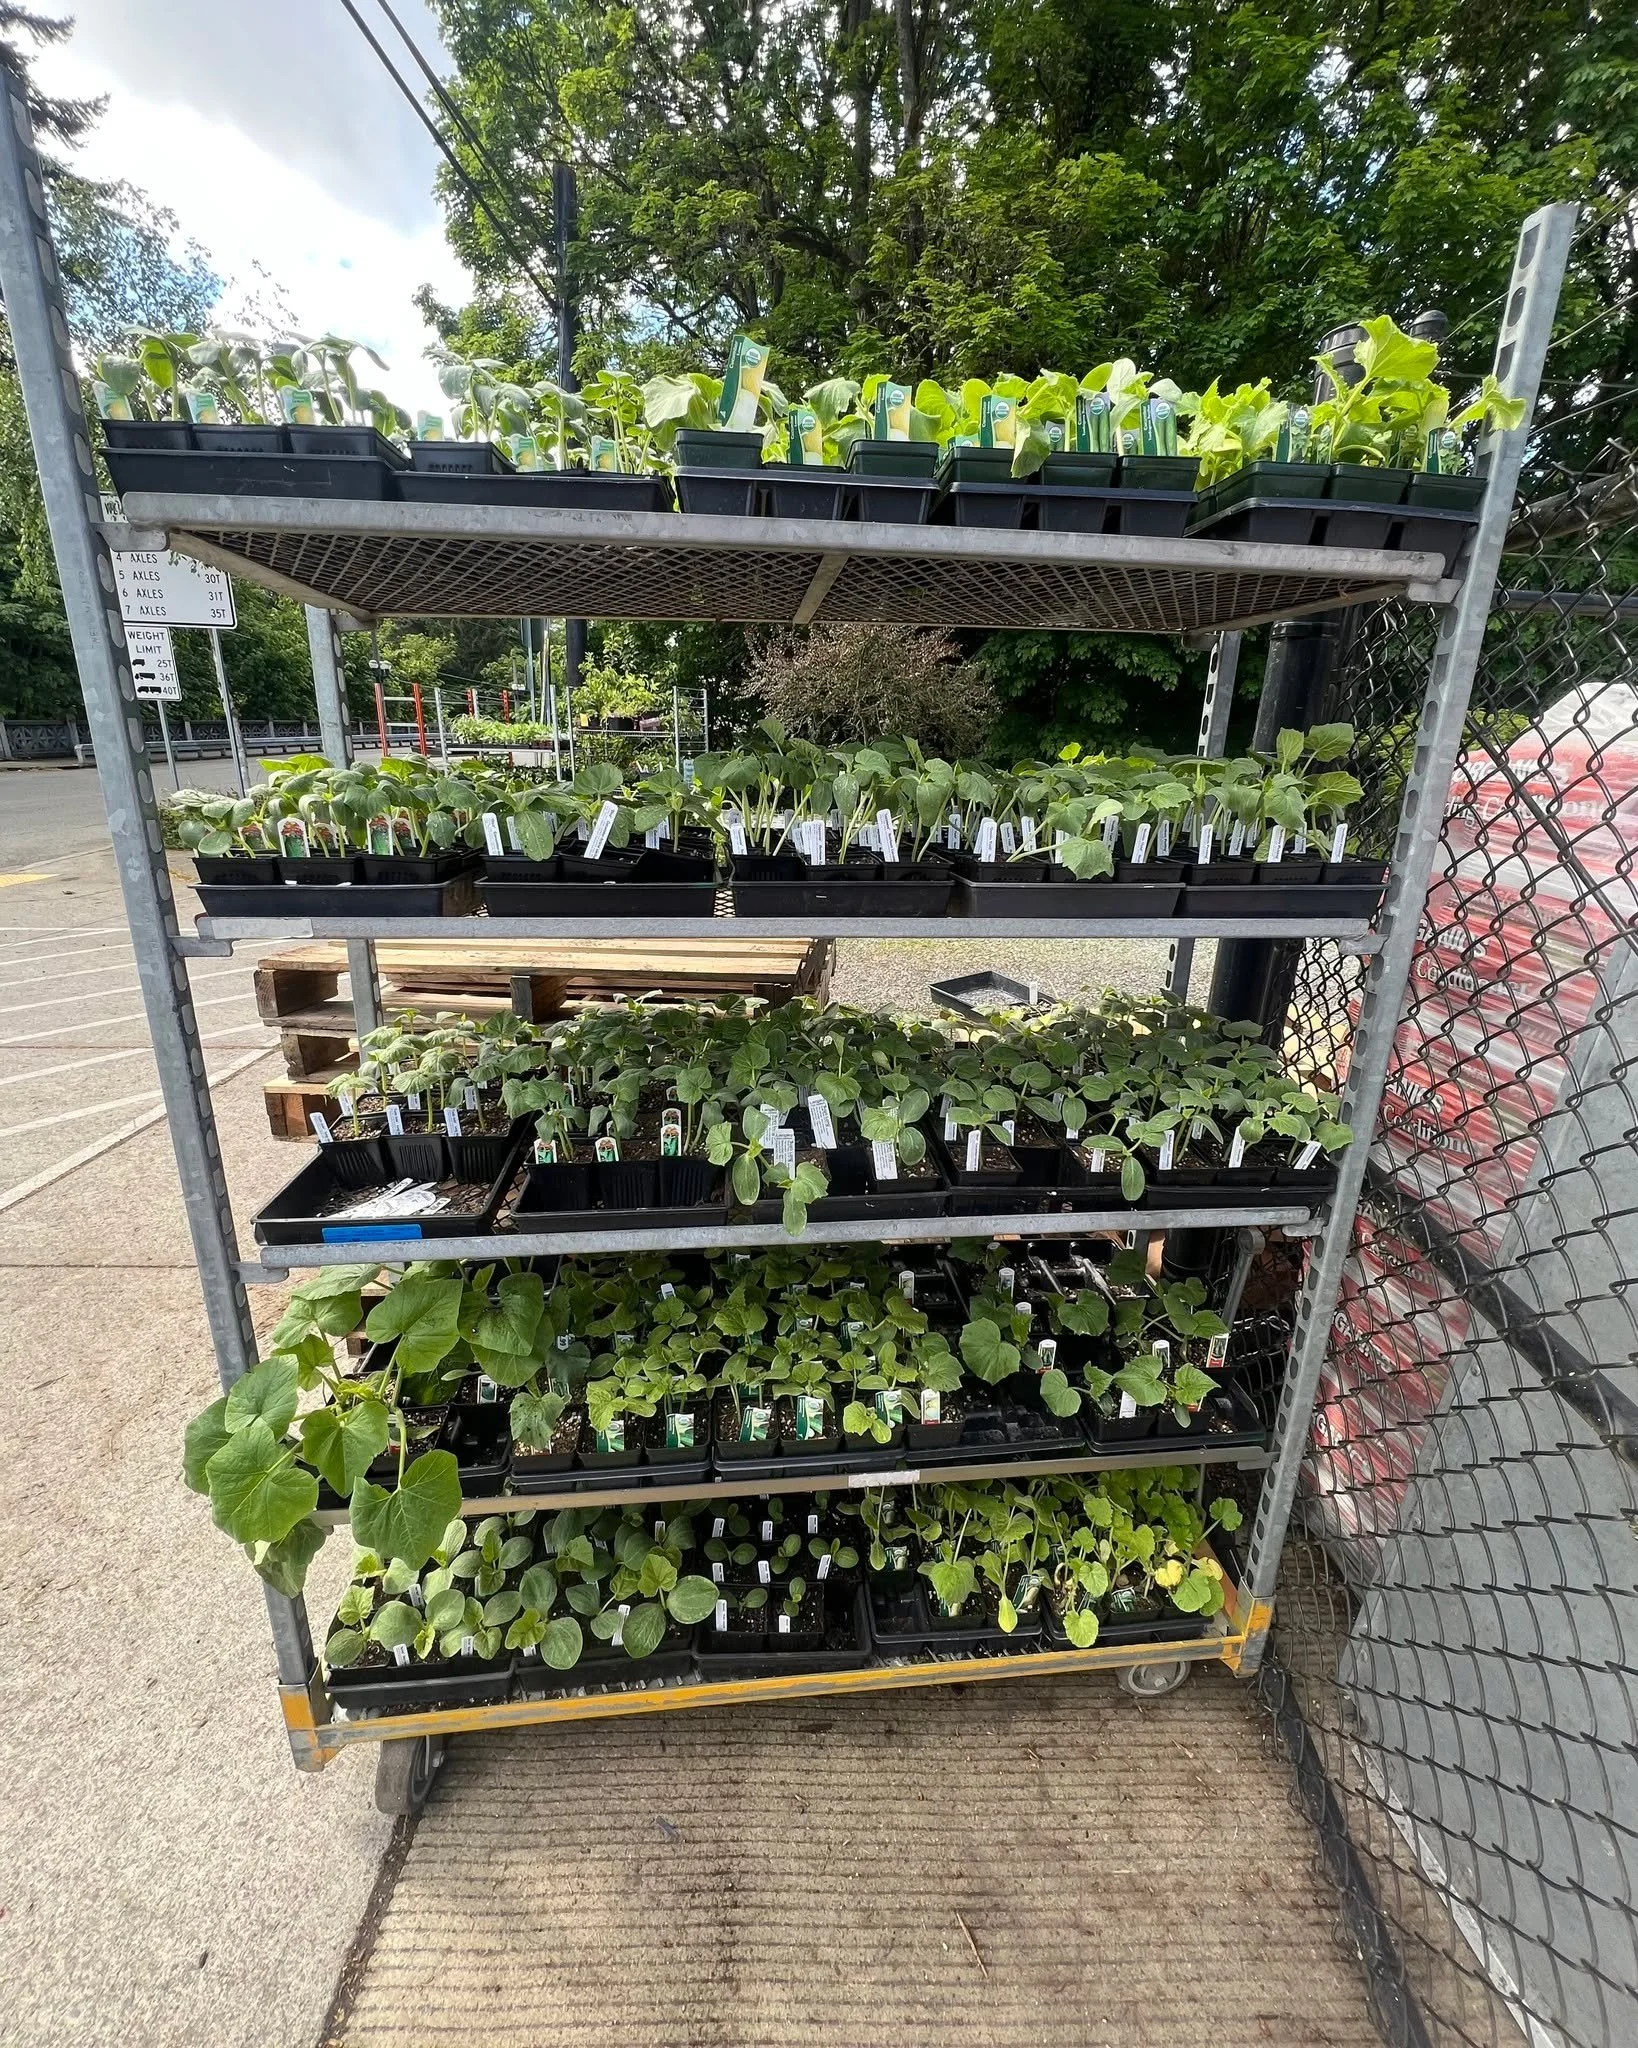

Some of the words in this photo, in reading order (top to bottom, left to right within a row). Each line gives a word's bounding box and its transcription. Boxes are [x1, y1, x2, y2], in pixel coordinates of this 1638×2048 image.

[116, 553, 122, 562] 4
[130, 553, 158, 564] AXLES
[119, 570, 125, 580] 5
[133, 571, 161, 581] AXLES
[204, 573, 221, 584] 30T
[122, 588, 128, 597] 6
[136, 589, 164, 599] AXLES
[208, 591, 223, 601] 31T
[125, 604, 131, 615] 7
[140, 606, 167, 616] AXLES
[211, 608, 226, 619] 35T
[127, 631, 165, 640] WEIGHT
[136, 645, 162, 654] LIMIT
[157, 660, 172, 668] 25T
[160, 673, 174, 681] 36T
[163, 686, 177, 695] 40T
